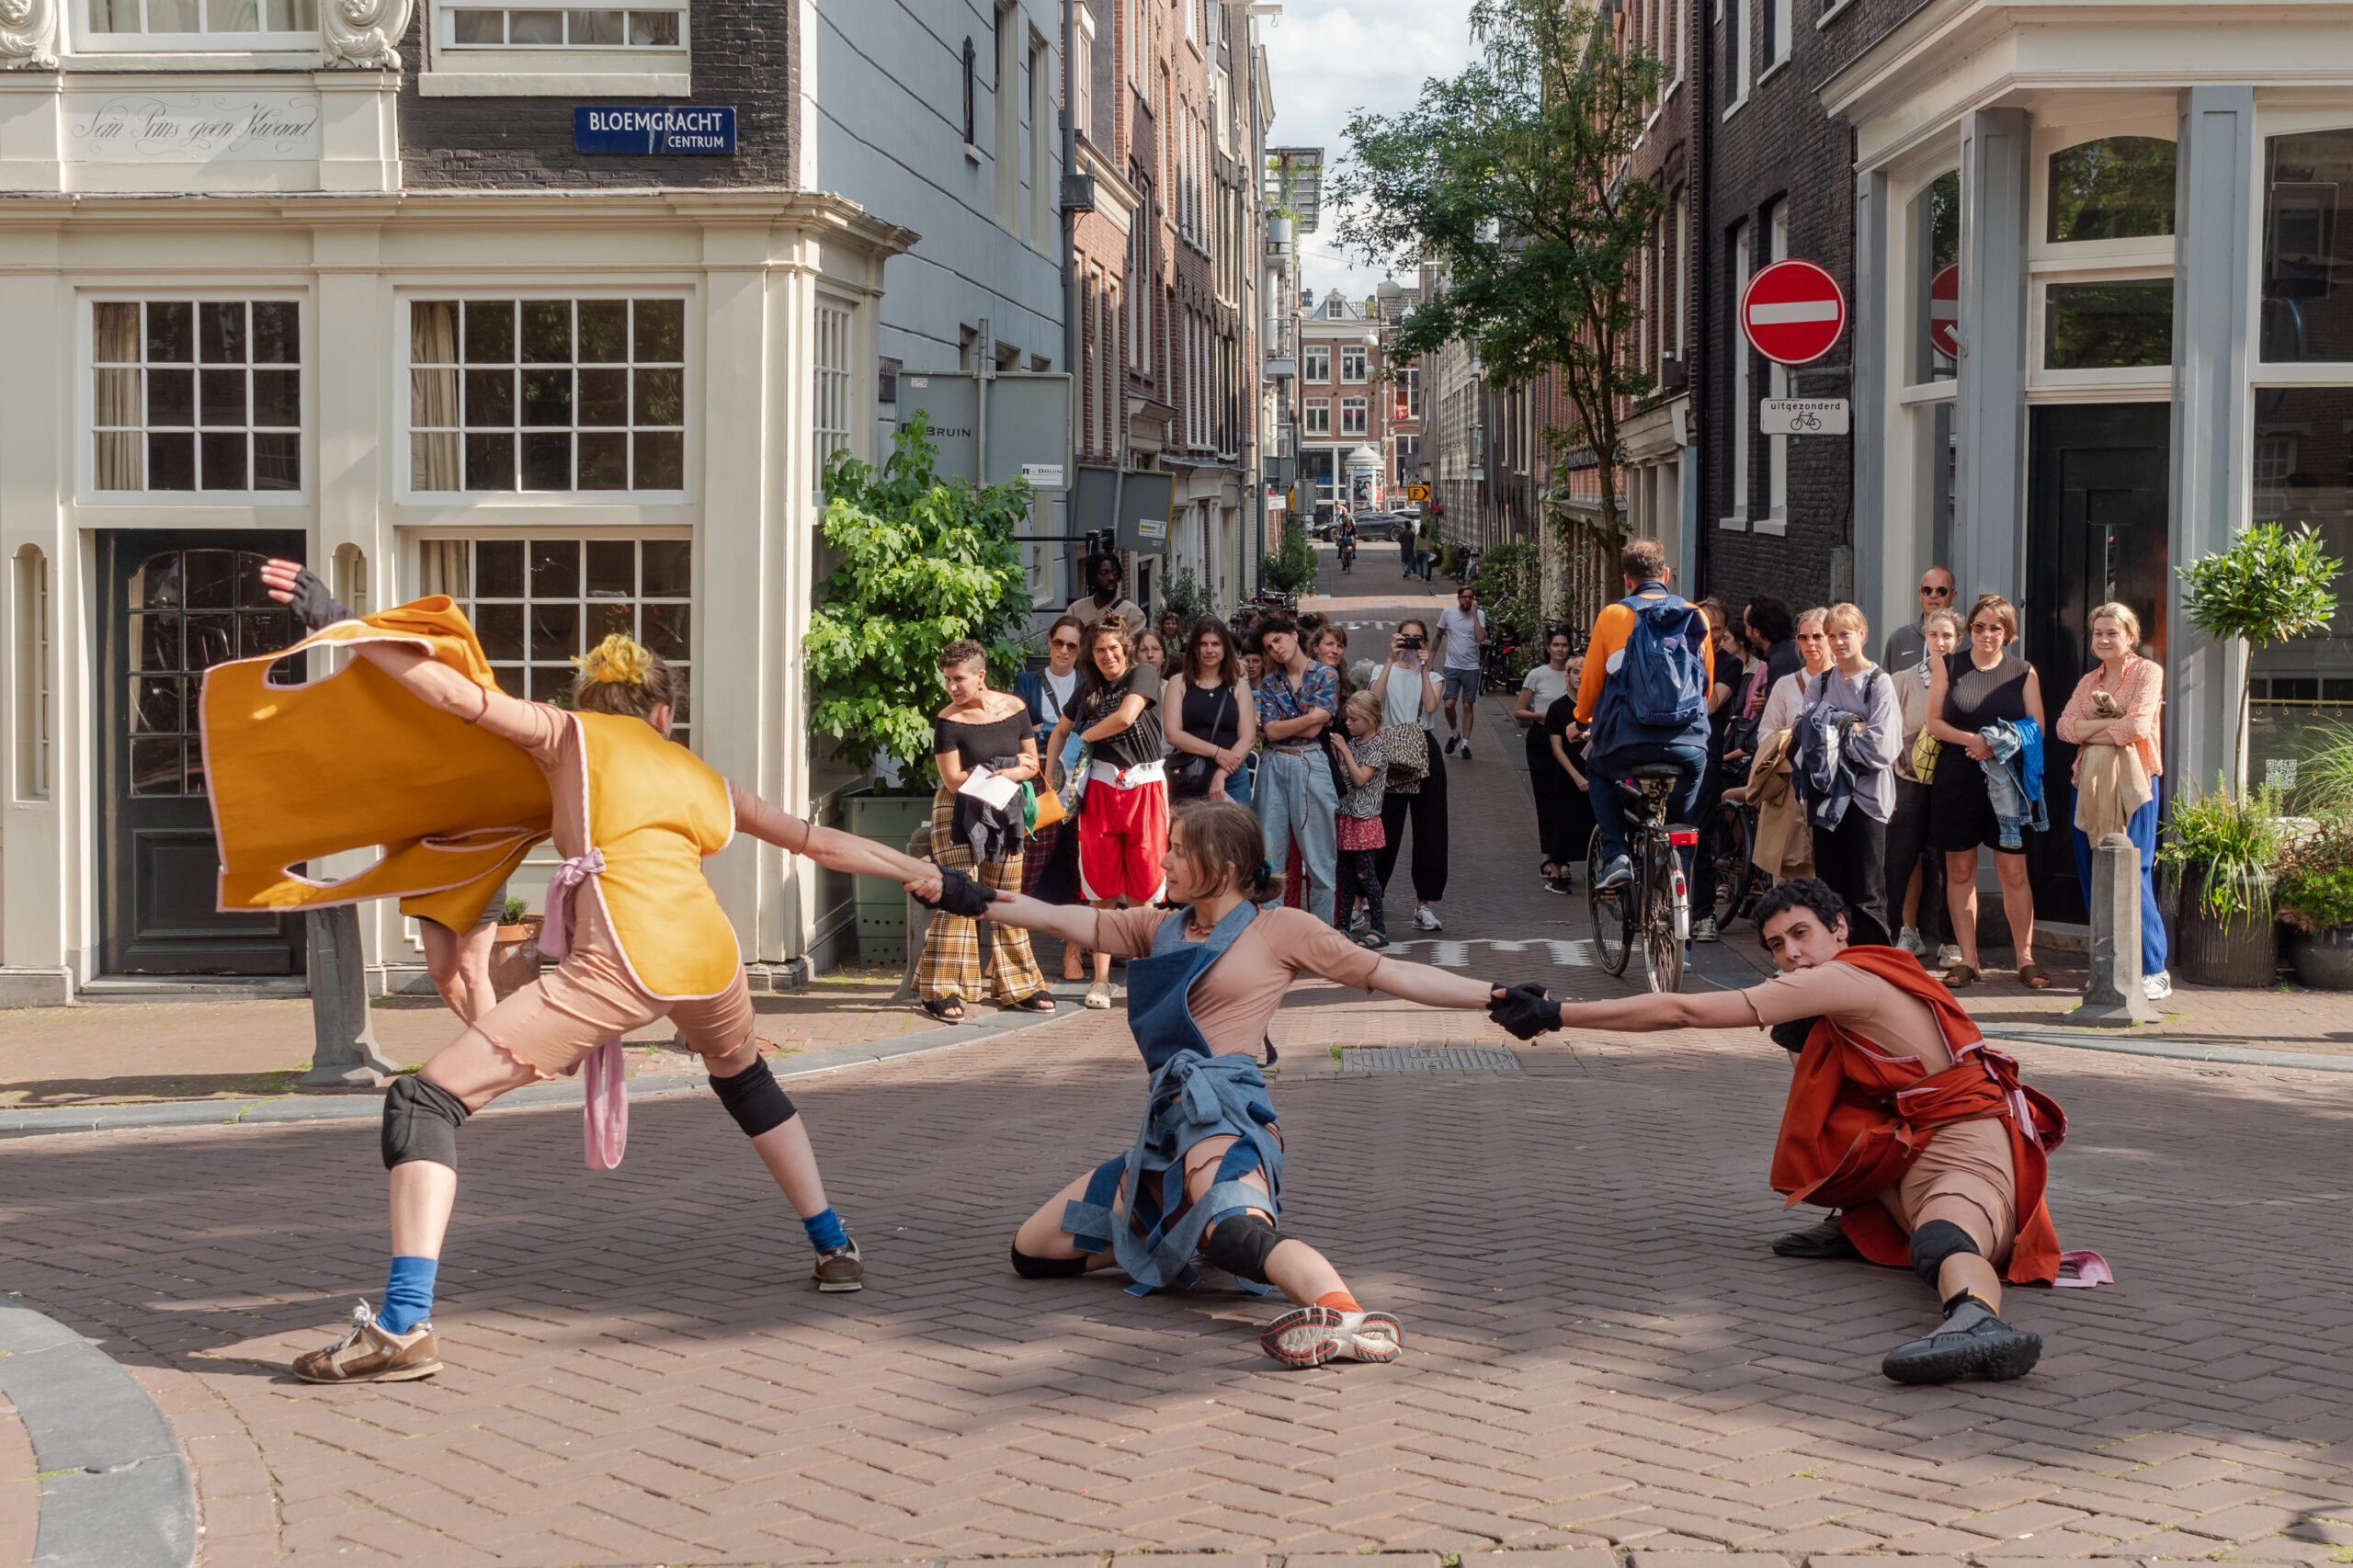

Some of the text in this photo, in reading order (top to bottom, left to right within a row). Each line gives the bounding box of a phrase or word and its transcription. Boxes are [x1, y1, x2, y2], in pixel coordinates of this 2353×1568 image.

[131, 102, 181, 140] Prins
[186, 121, 234, 148] geen
[234, 101, 318, 138] Kwaad
[589, 112, 723, 131] BLOEMGRACHT
[667, 135, 725, 149] CENTRUM
[1770, 402, 1841, 412] uitgezonderd
[926, 426, 972, 438] BRUIN
[1413, 488, 1420, 498] F
